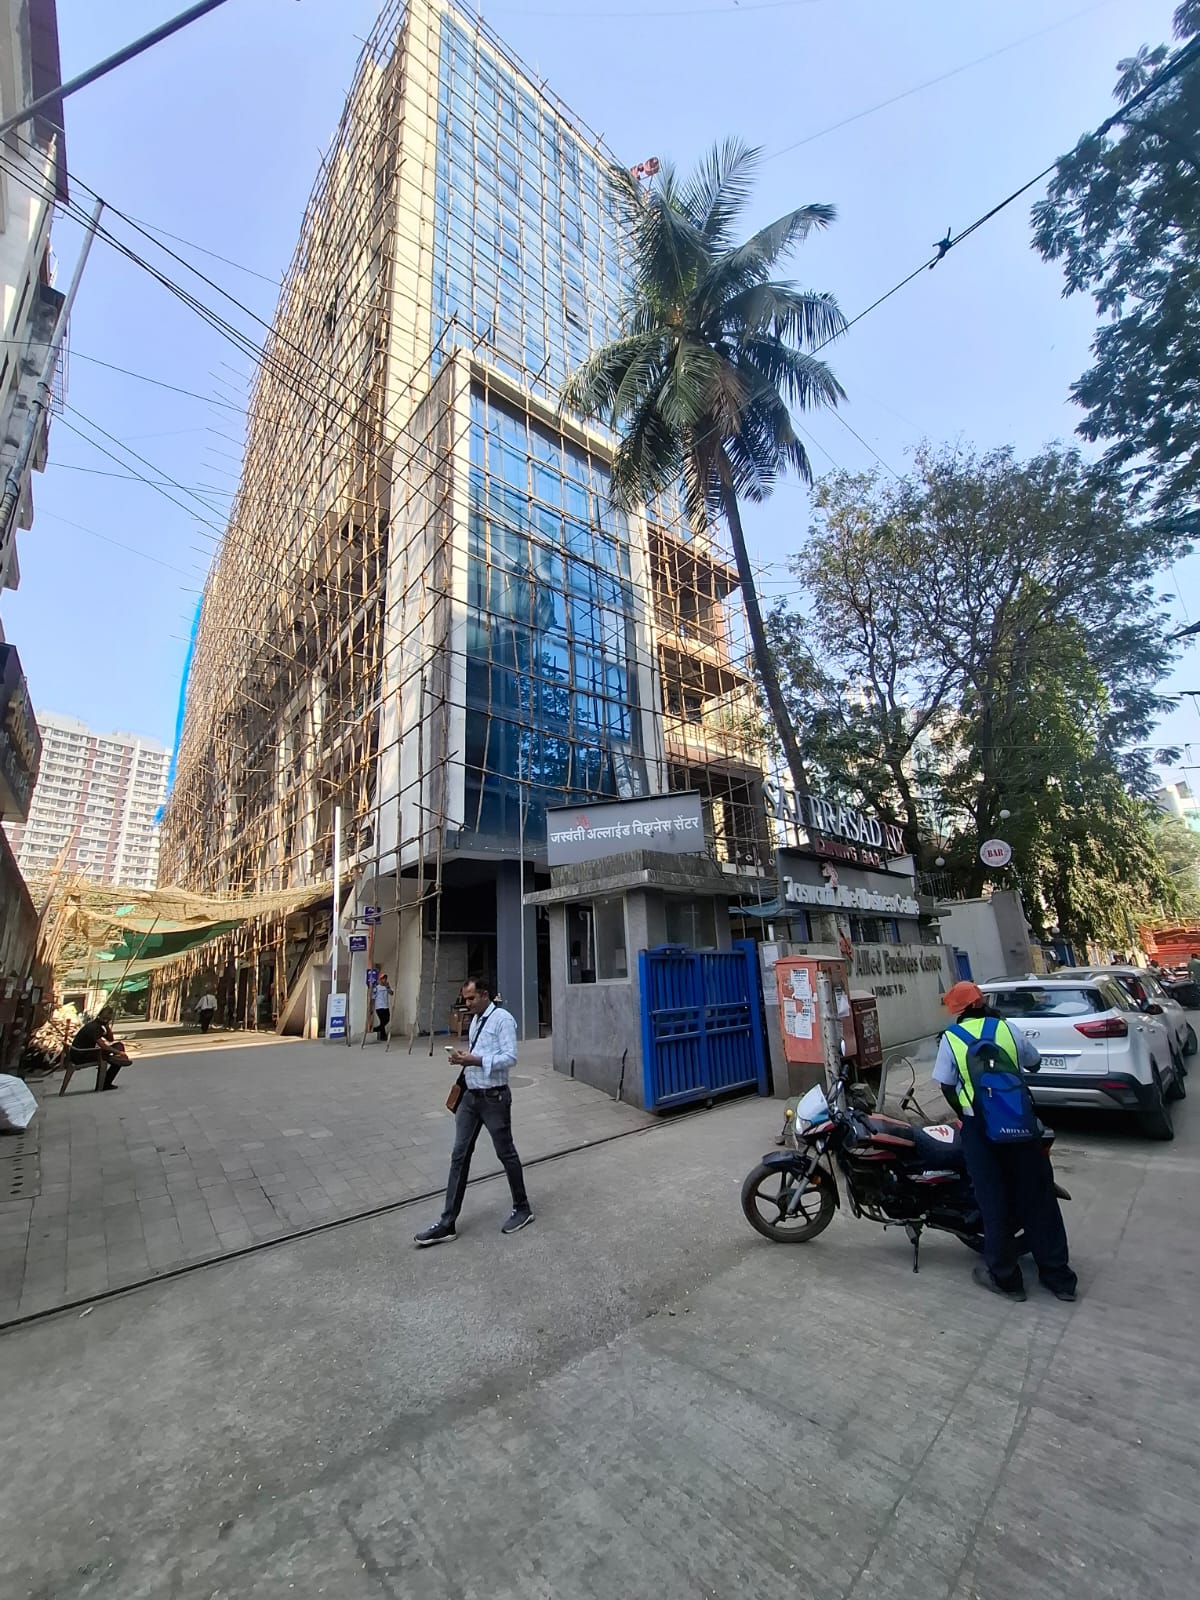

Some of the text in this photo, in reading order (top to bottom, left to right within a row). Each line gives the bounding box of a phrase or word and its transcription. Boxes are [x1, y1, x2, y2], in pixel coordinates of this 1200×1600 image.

[673, 814, 699, 831] सेंटर
[762, 780, 805, 826] SAI
[808, 795, 882, 847] PRASAD
[861, 848, 880, 868] BAR
[986, 848, 1004, 858] BAR
